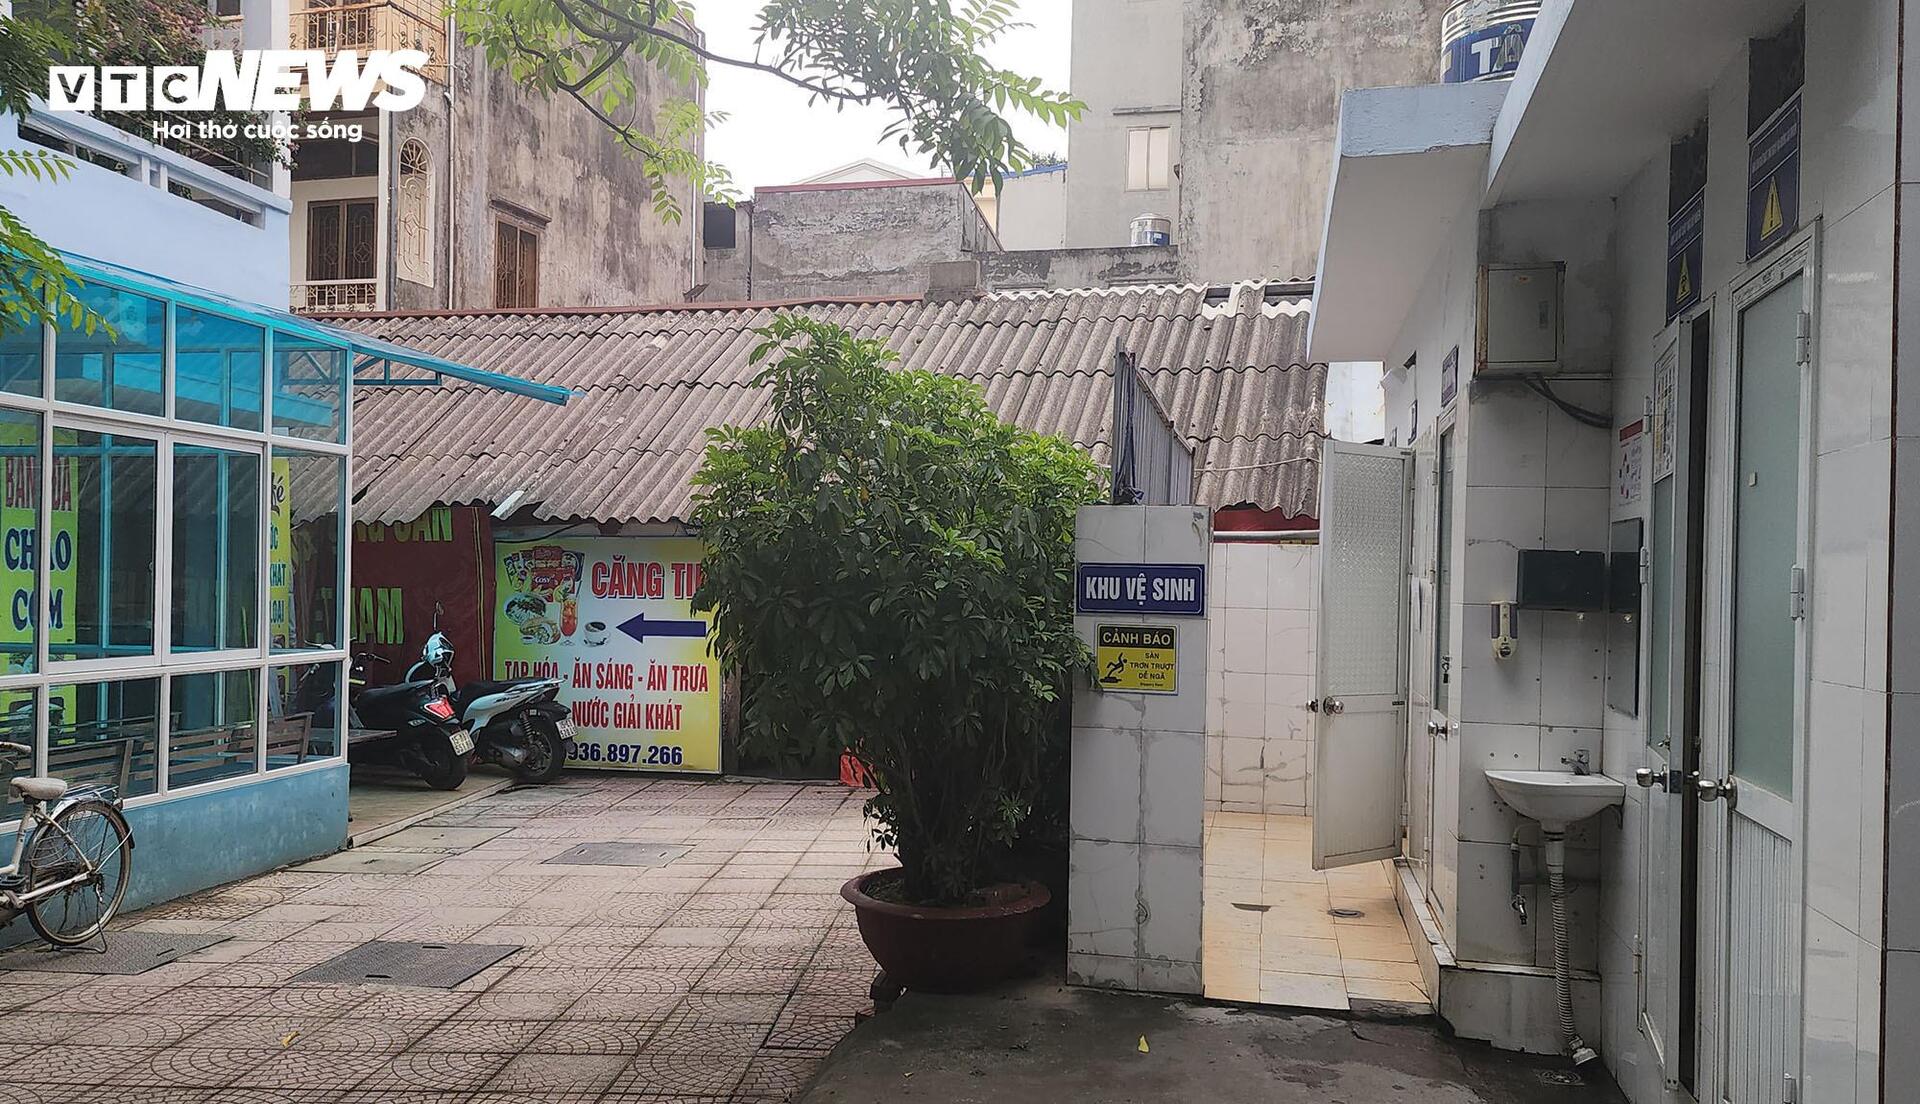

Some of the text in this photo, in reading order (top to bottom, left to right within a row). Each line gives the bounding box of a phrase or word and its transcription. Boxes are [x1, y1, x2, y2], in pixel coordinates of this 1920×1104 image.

[592, 554, 664, 599] CĂNG
[1086, 573, 1196, 606] KHU VỆ SINH
[1102, 628, 1171, 646] CẢNH BÁO
[572, 657, 592, 689] ĂN
[596, 657, 633, 690] SÁNG
[647, 658, 667, 691] ĂN
[672, 663, 709, 692] TRƯA
[572, 696, 609, 728] NƯỚC
[614, 693, 641, 730] GIẢI
[646, 698, 682, 730] KHÁT
[568, 742, 683, 765] 936.897.266
